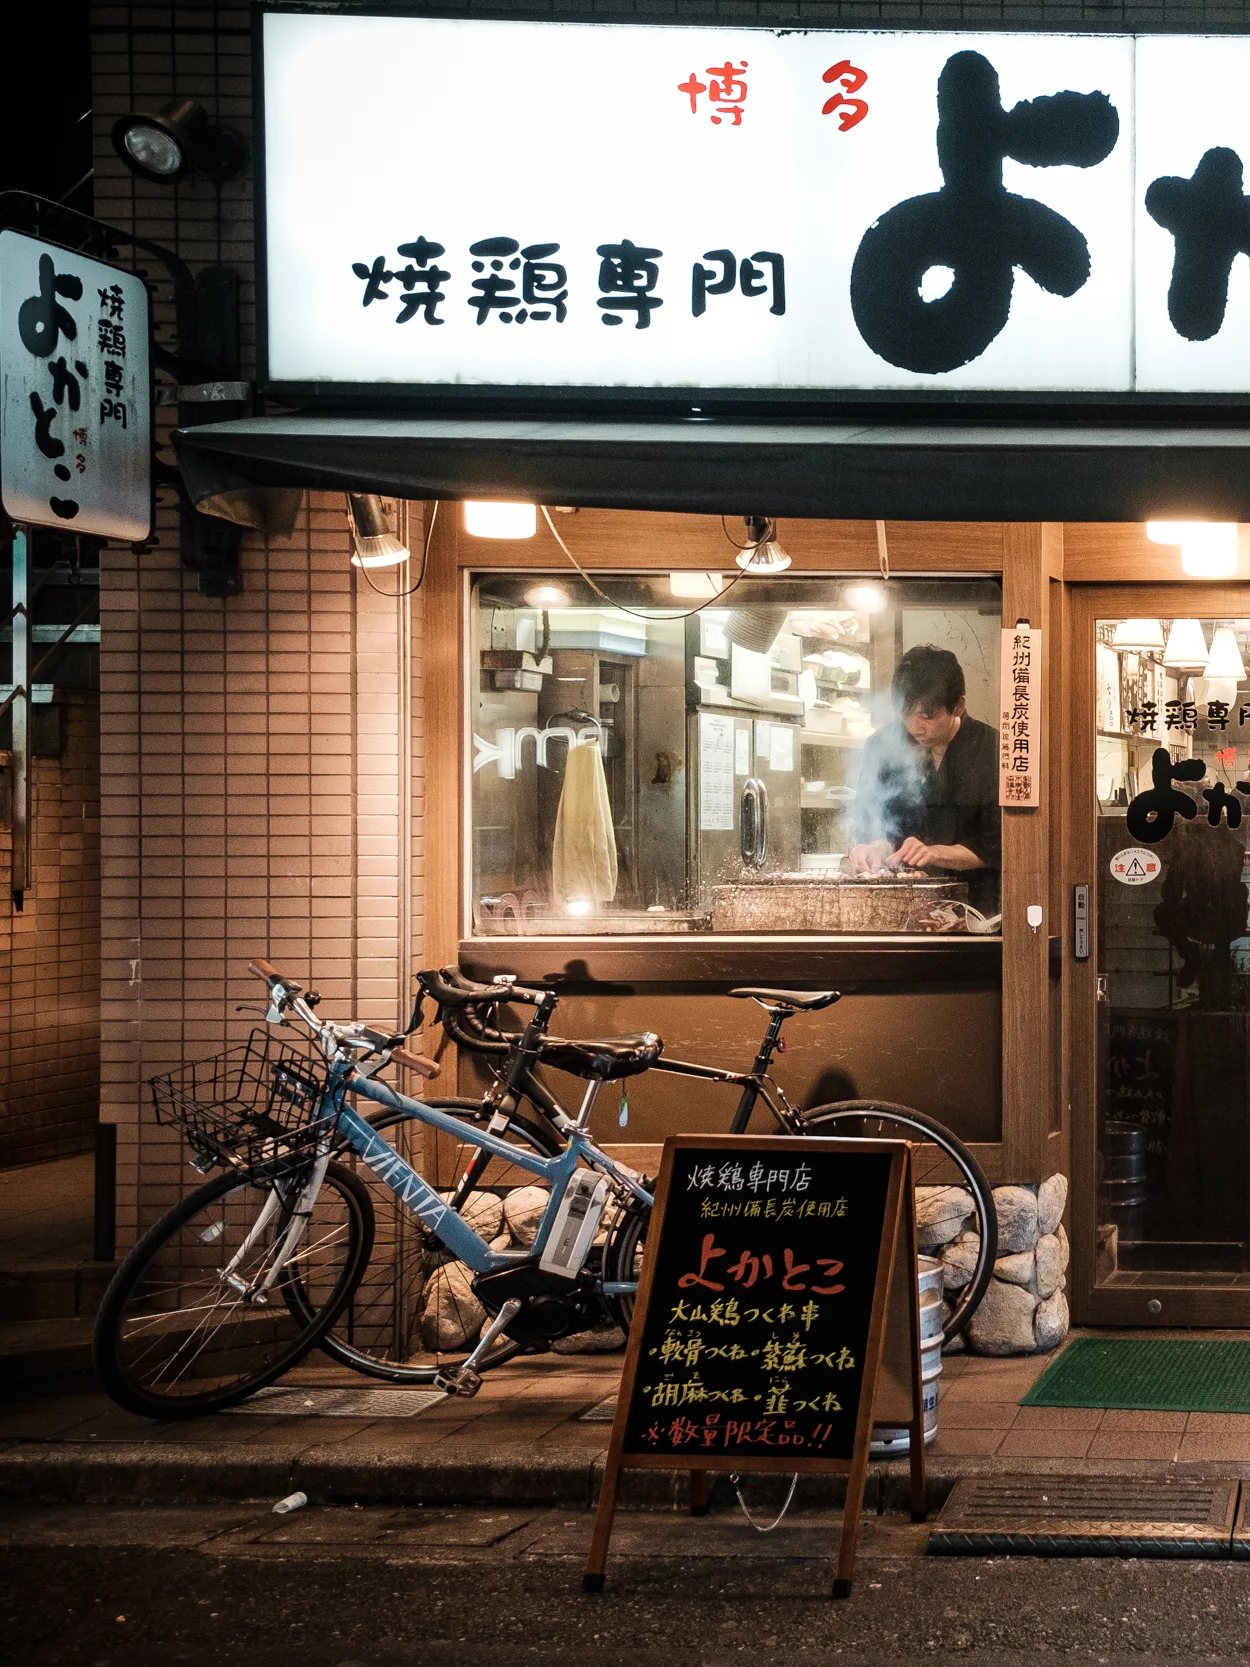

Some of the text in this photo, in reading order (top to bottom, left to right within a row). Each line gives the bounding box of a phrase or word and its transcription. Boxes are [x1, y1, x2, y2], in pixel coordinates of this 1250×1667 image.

[677, 60, 870, 133] 博多
[351, 235, 787, 330] 焼鶏専門
[18, 252, 89, 520] よかとこ
[97, 284, 127, 430] 焼鶏専門
[72, 426, 89, 474] 博多
[1011, 634, 1031, 773] 紀州備長炭使用店
[363, 1135, 449, 1230] VIENTA
[687, 1160, 813, 1193] 焼鶏専門店
[700, 1196, 849, 1222] 紀州備長炭使用店
[677, 1233, 846, 1296] よかとこ
[668, 1297, 820, 1332] 大山鶏つくね串
